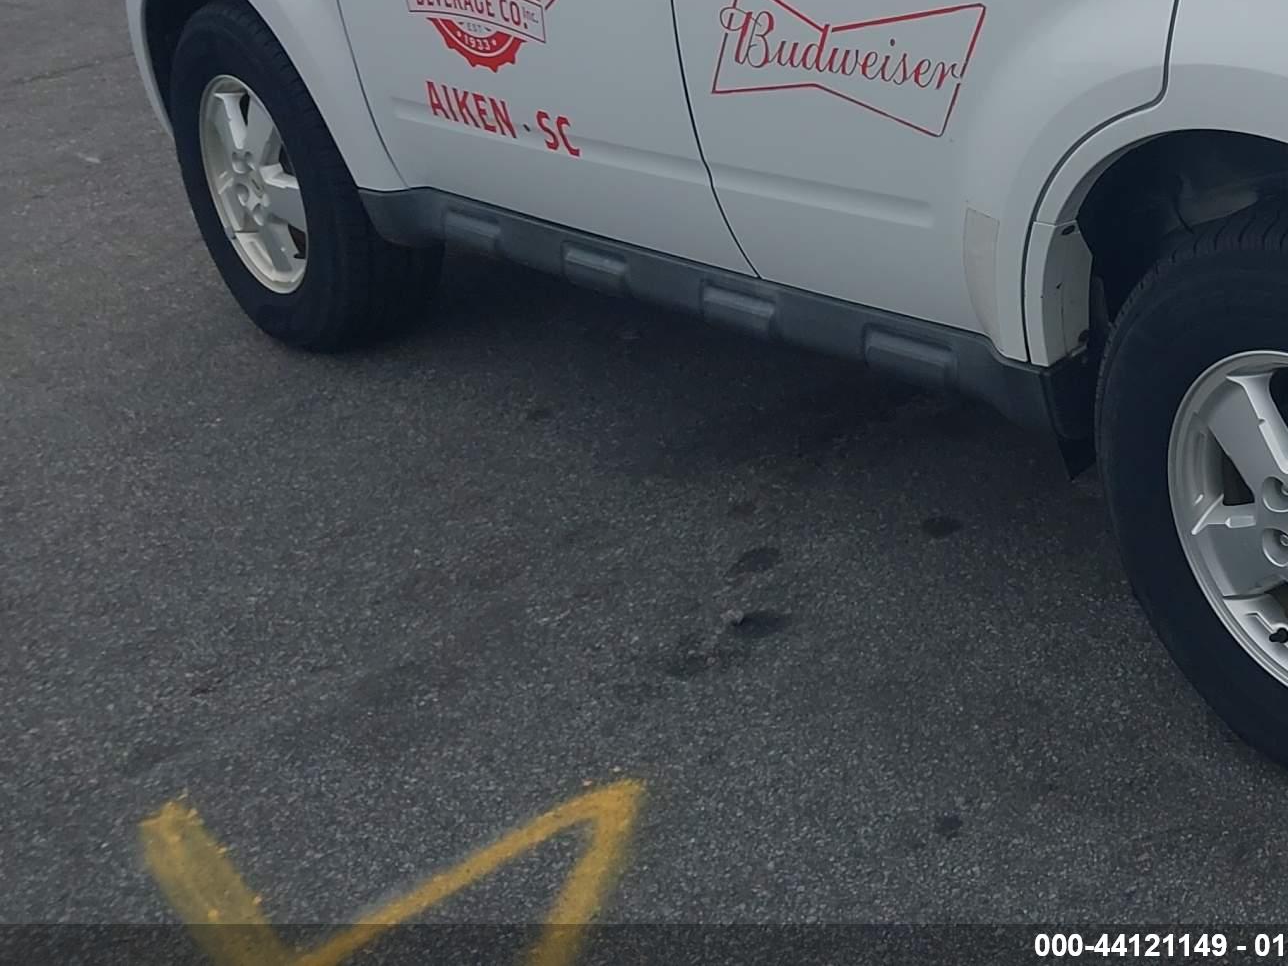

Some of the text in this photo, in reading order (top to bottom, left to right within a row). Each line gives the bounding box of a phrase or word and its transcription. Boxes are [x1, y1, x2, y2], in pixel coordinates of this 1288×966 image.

[464, 34, 491, 51] 1933
[719, 6, 962, 91] Budweiser
[426, 80, 581, 157] AIKEN SC
